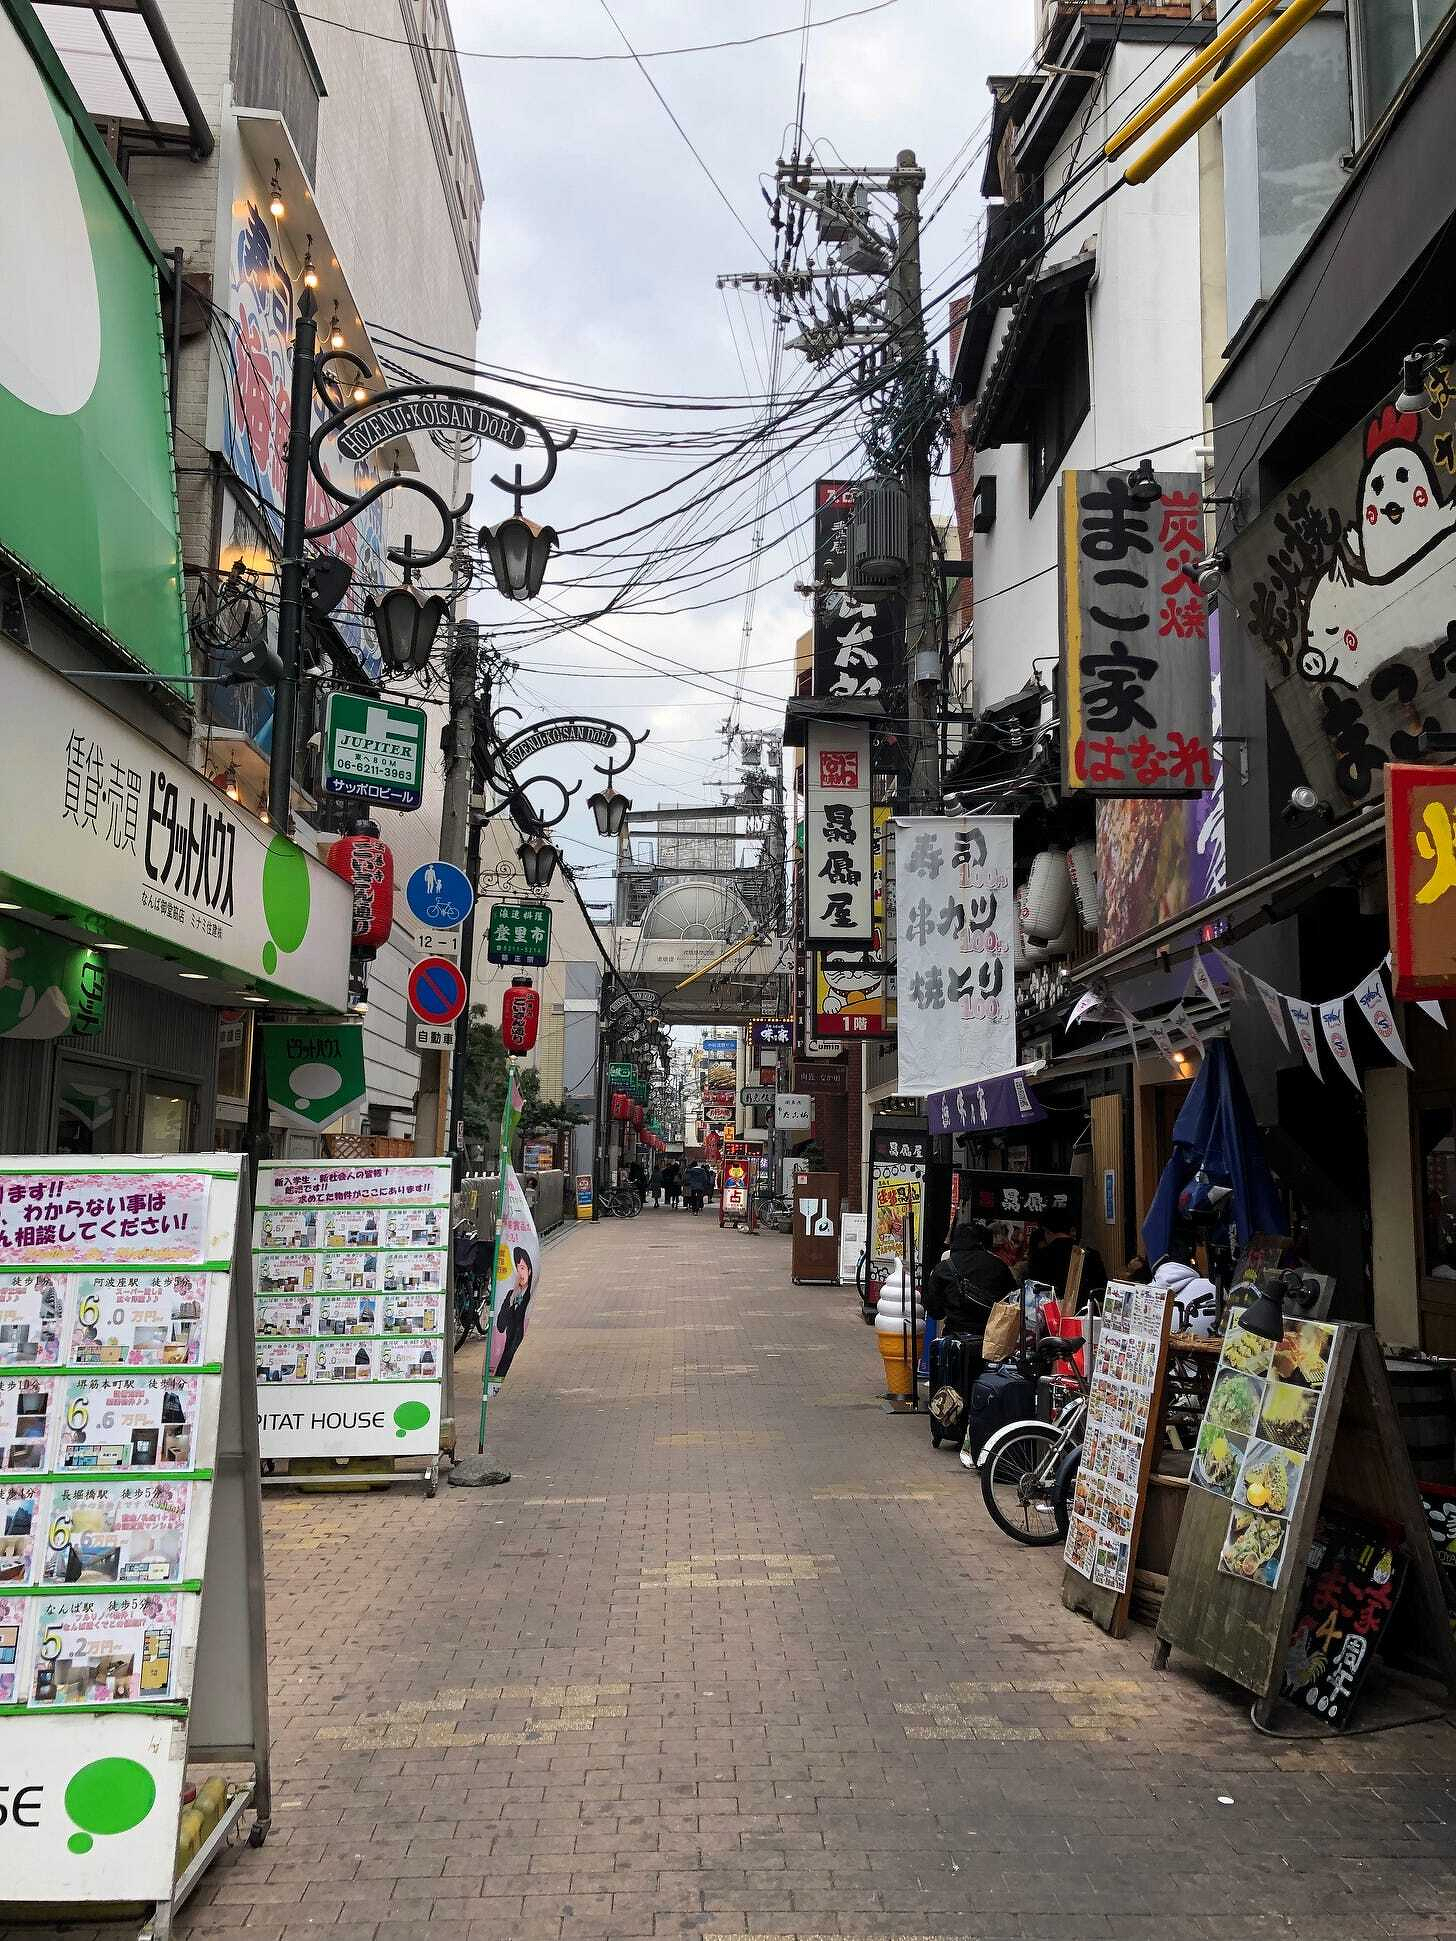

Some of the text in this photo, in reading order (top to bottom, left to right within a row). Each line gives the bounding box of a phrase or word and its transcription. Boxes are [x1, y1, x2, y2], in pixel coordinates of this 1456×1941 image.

[1158, 490, 1208, 640] 炭火焼
[1080, 476, 1160, 733] まこ家
[340, 735, 412, 758] JUPITER
[337, 759, 412, 780] 06-6211-3963
[1074, 731, 1218, 787] はなれ
[62, 728, 142, 857] 賃貸・売買
[333, 779, 414, 803] サッポロビール
[144, 770, 236, 918] ピタットハウス
[905, 828, 988, 881] 寿司
[905, 891, 998, 947] 串カツ
[910, 956, 1004, 1010] 焼とり
[843, 1016, 868, 1031] 1階
[286, 1038, 343, 1060] ピタットハウス
[418, 1030, 454, 1046] 自動車
[809, 1041, 840, 1051] Cumin
[730, 1190, 742, 1203] 占
[311, 1411, 385, 1430] HOUSE
[46, 1600, 95, 1617] なんば駅
